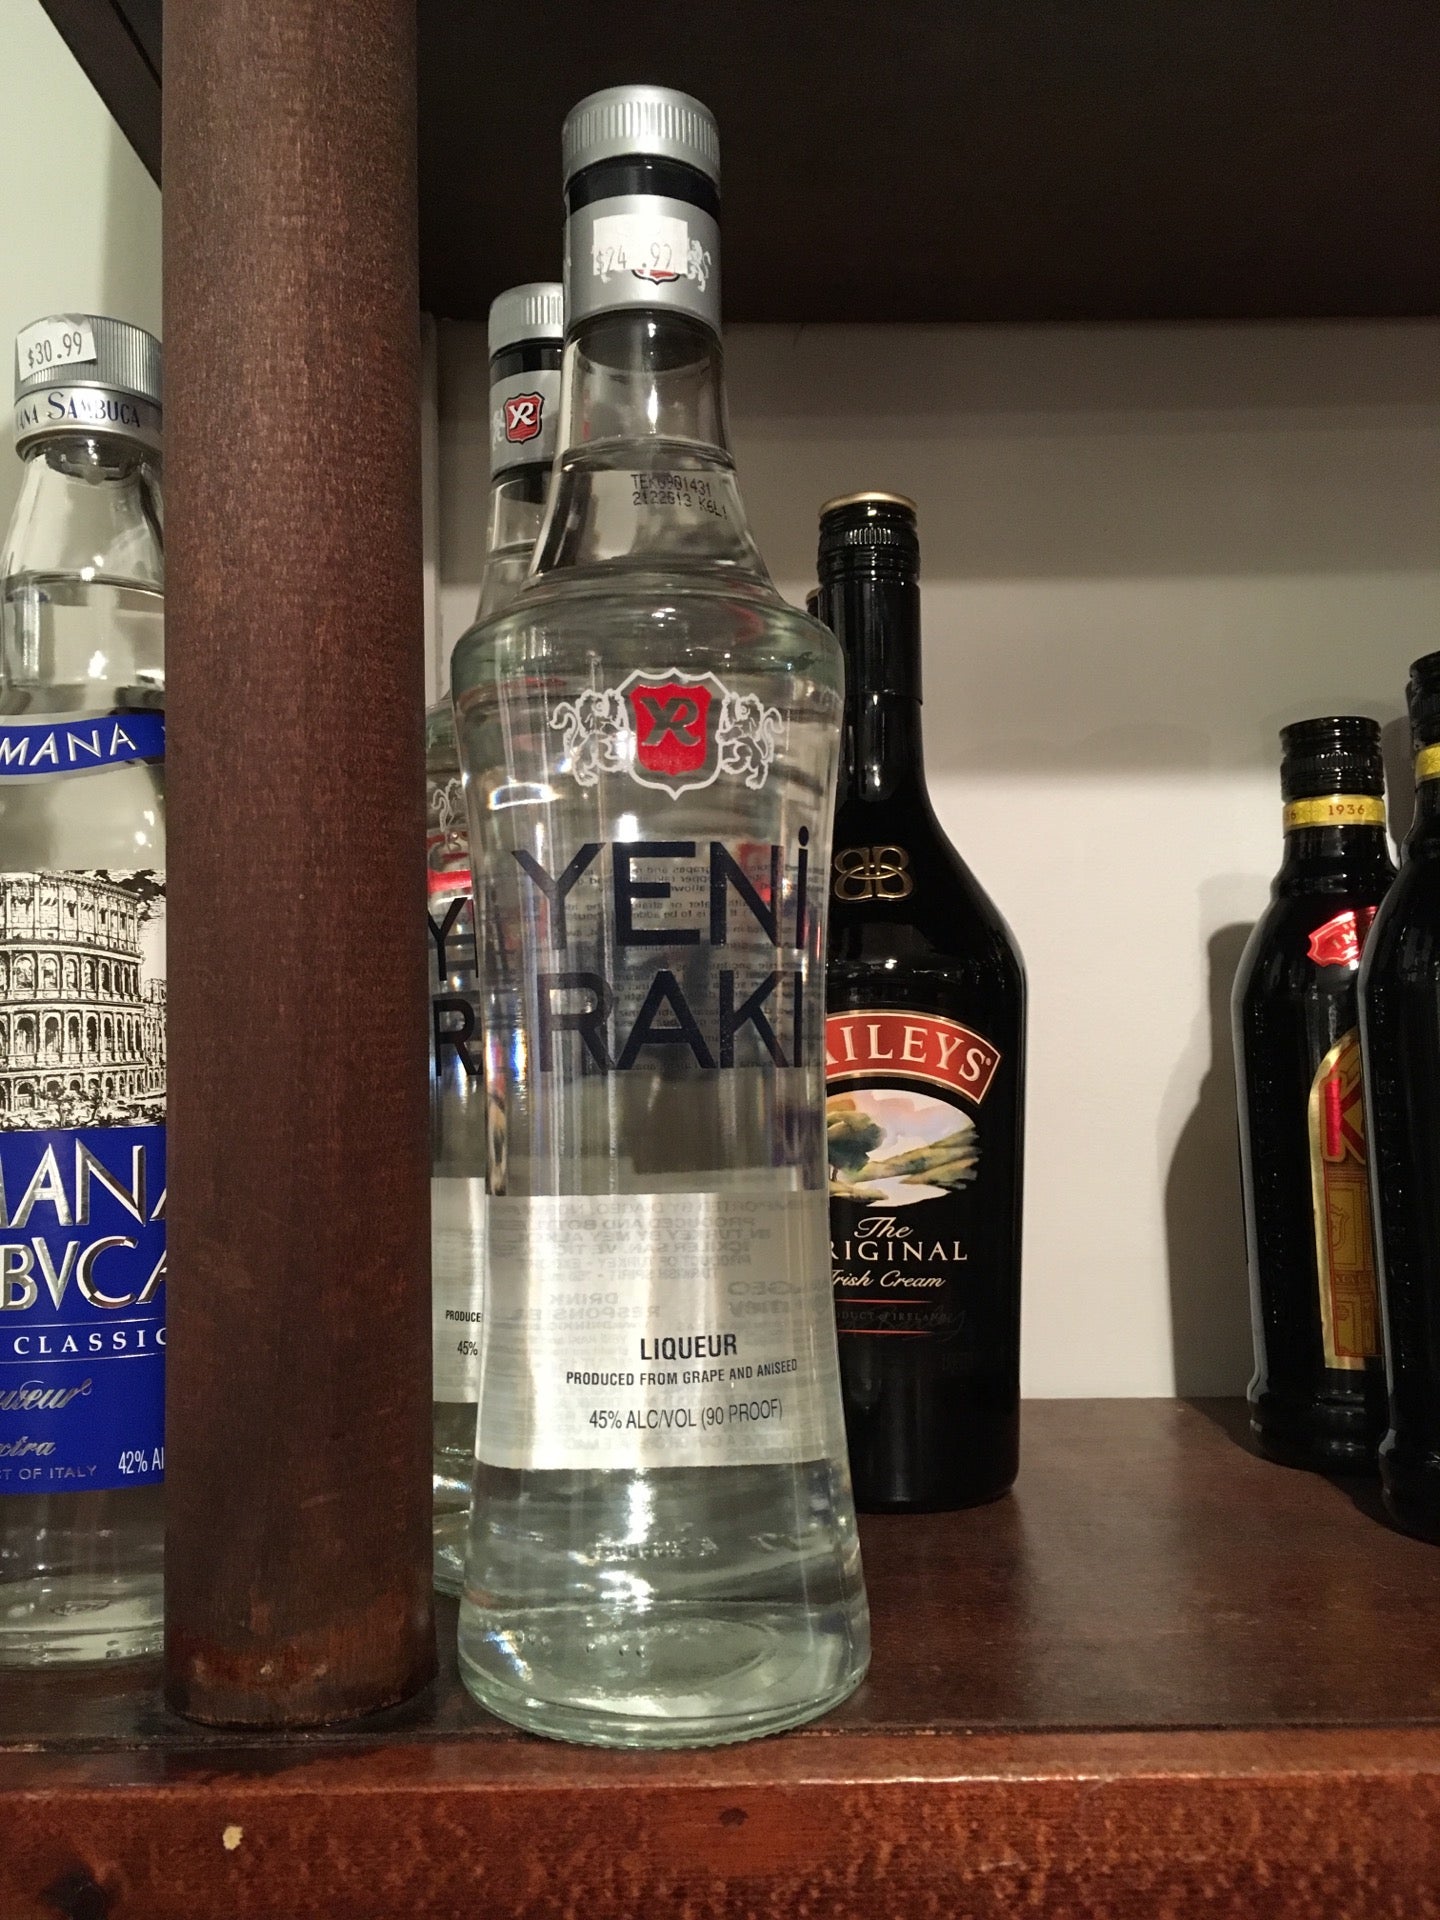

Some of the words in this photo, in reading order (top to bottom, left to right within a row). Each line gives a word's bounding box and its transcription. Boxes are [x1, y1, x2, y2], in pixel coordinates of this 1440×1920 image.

[27, 332, 82, 369] $30.99
[1328, 804, 1366, 817] 1936
[537, 968, 804, 1076] RAKI
[854, 1216, 914, 1239] The
[880, 1269, 946, 1288] Cream
[13, 1327, 167, 1355] CLASSIC
[457, 1340, 479, 1356] 45%
[640, 1333, 738, 1361] LIQUEUR
[566, 1370, 634, 1386] PRODUCED
[639, 1371, 678, 1386] FROM
[682, 1368, 725, 1385] GRAPE
[729, 1365, 753, 1381] AND
[757, 1358, 798, 1378] ANISEED
[589, 1409, 622, 1430] 45%
[625, 1407, 698, 1430] ALC/VOL
[701, 1404, 725, 1431] (90
[728, 1398, 784, 1425] PROOF)
[18, 1467, 43, 1480] OF
[50, 1464, 98, 1480] ITALY
[118, 1449, 148, 1475] 42%
